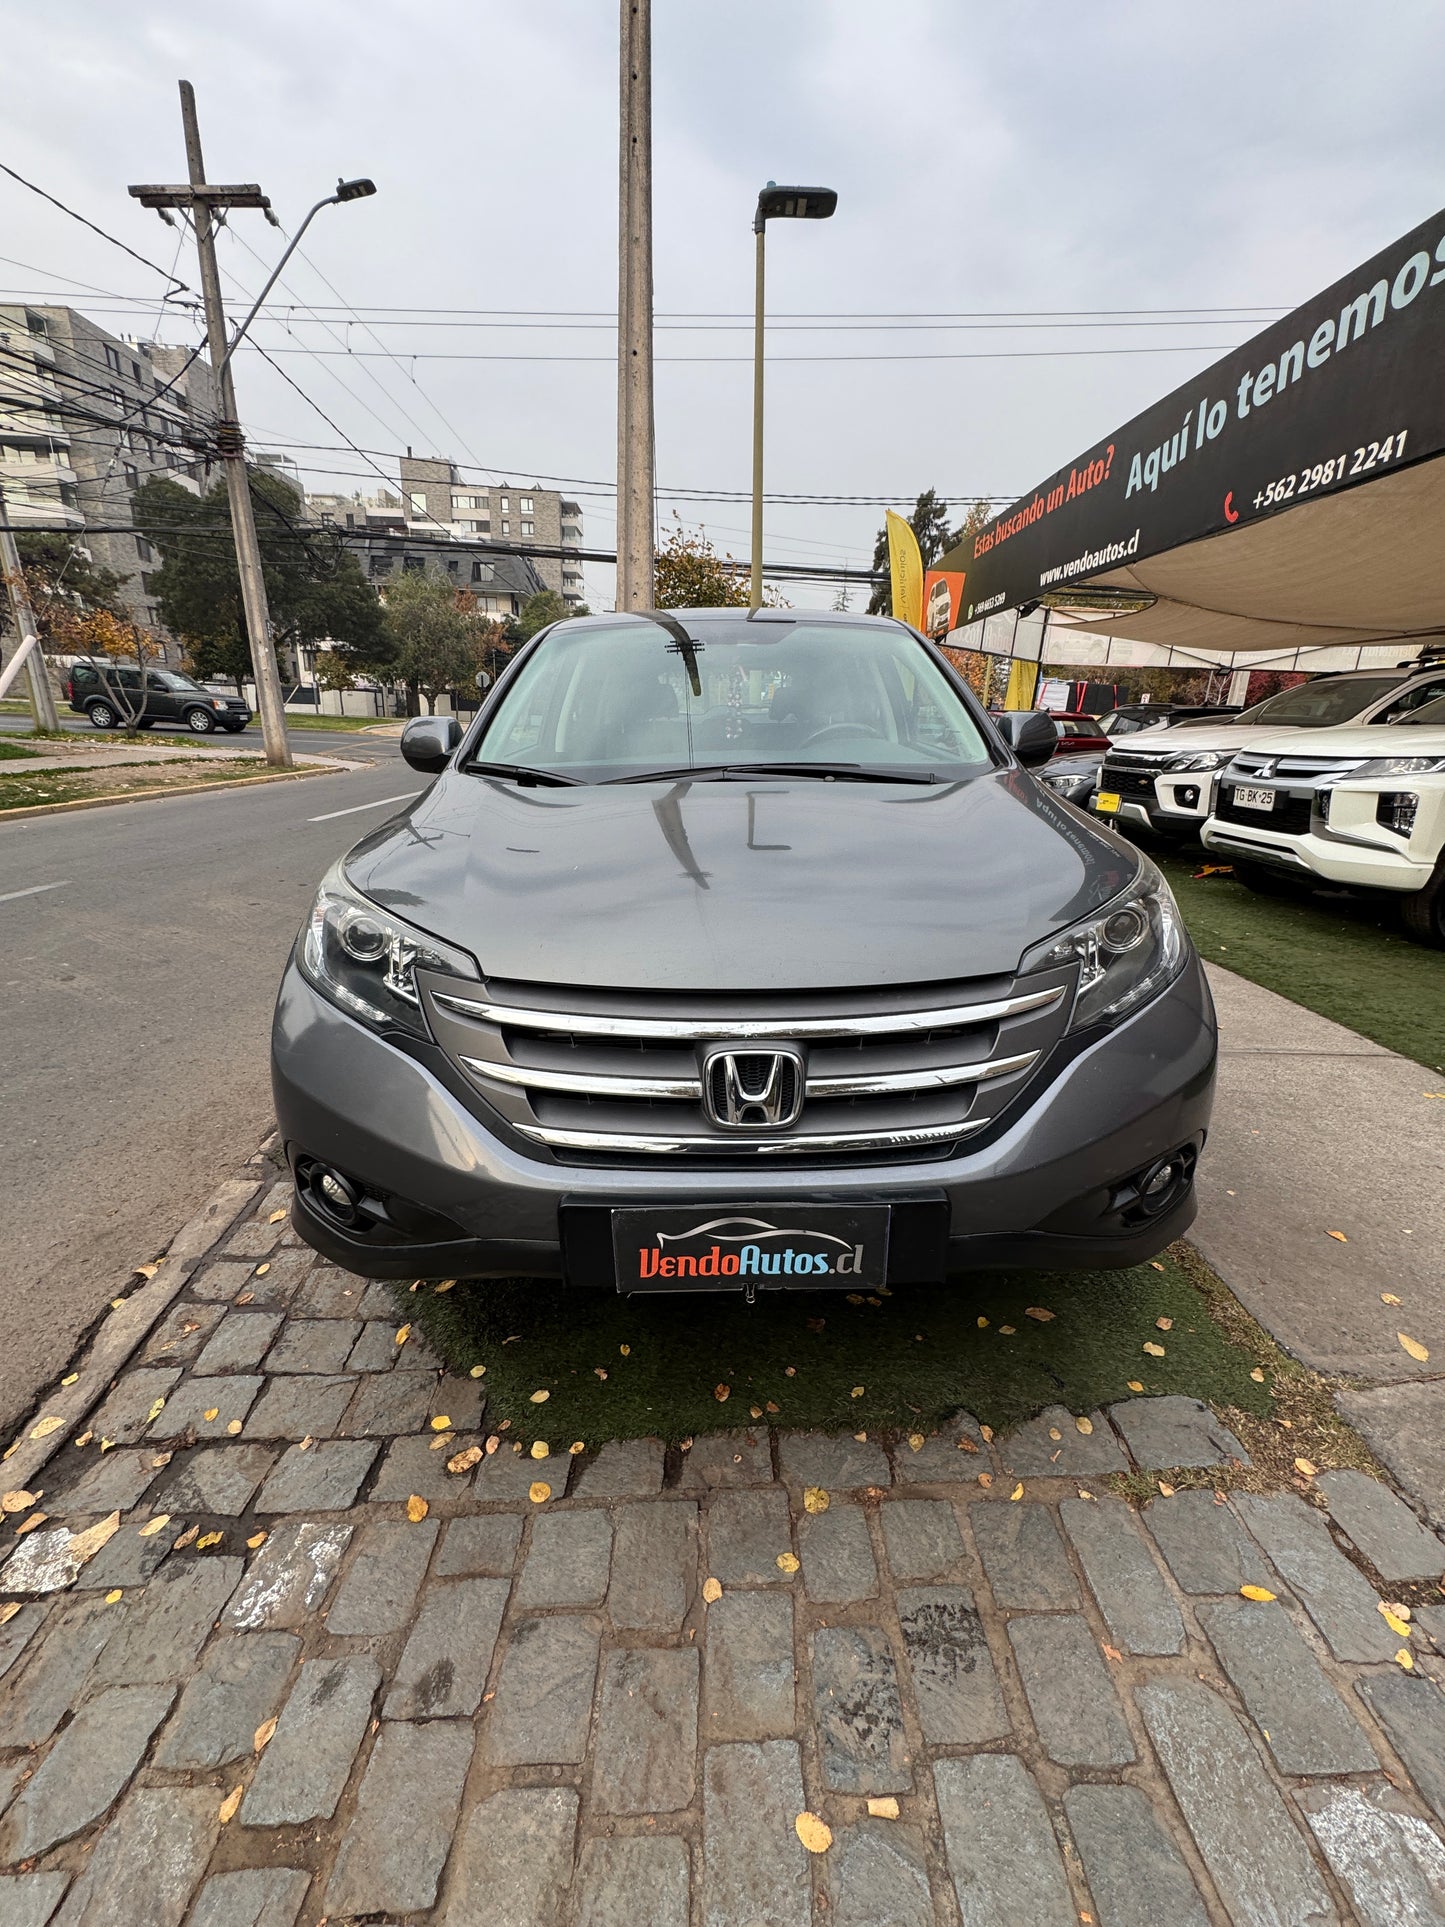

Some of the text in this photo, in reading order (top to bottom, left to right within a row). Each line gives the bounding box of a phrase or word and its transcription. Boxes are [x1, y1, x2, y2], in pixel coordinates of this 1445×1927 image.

[1125, 409, 1193, 500] Aquí
[1196, 397, 1227, 450] lo
[1252, 429, 1408, 510] +562 2981 2241
[973, 444, 1115, 560] Estas buscando un Auto?
[1039, 529, 1141, 587] www.vendoautos.cl
[639, 1244, 865, 1279] VendoAutos.cl
